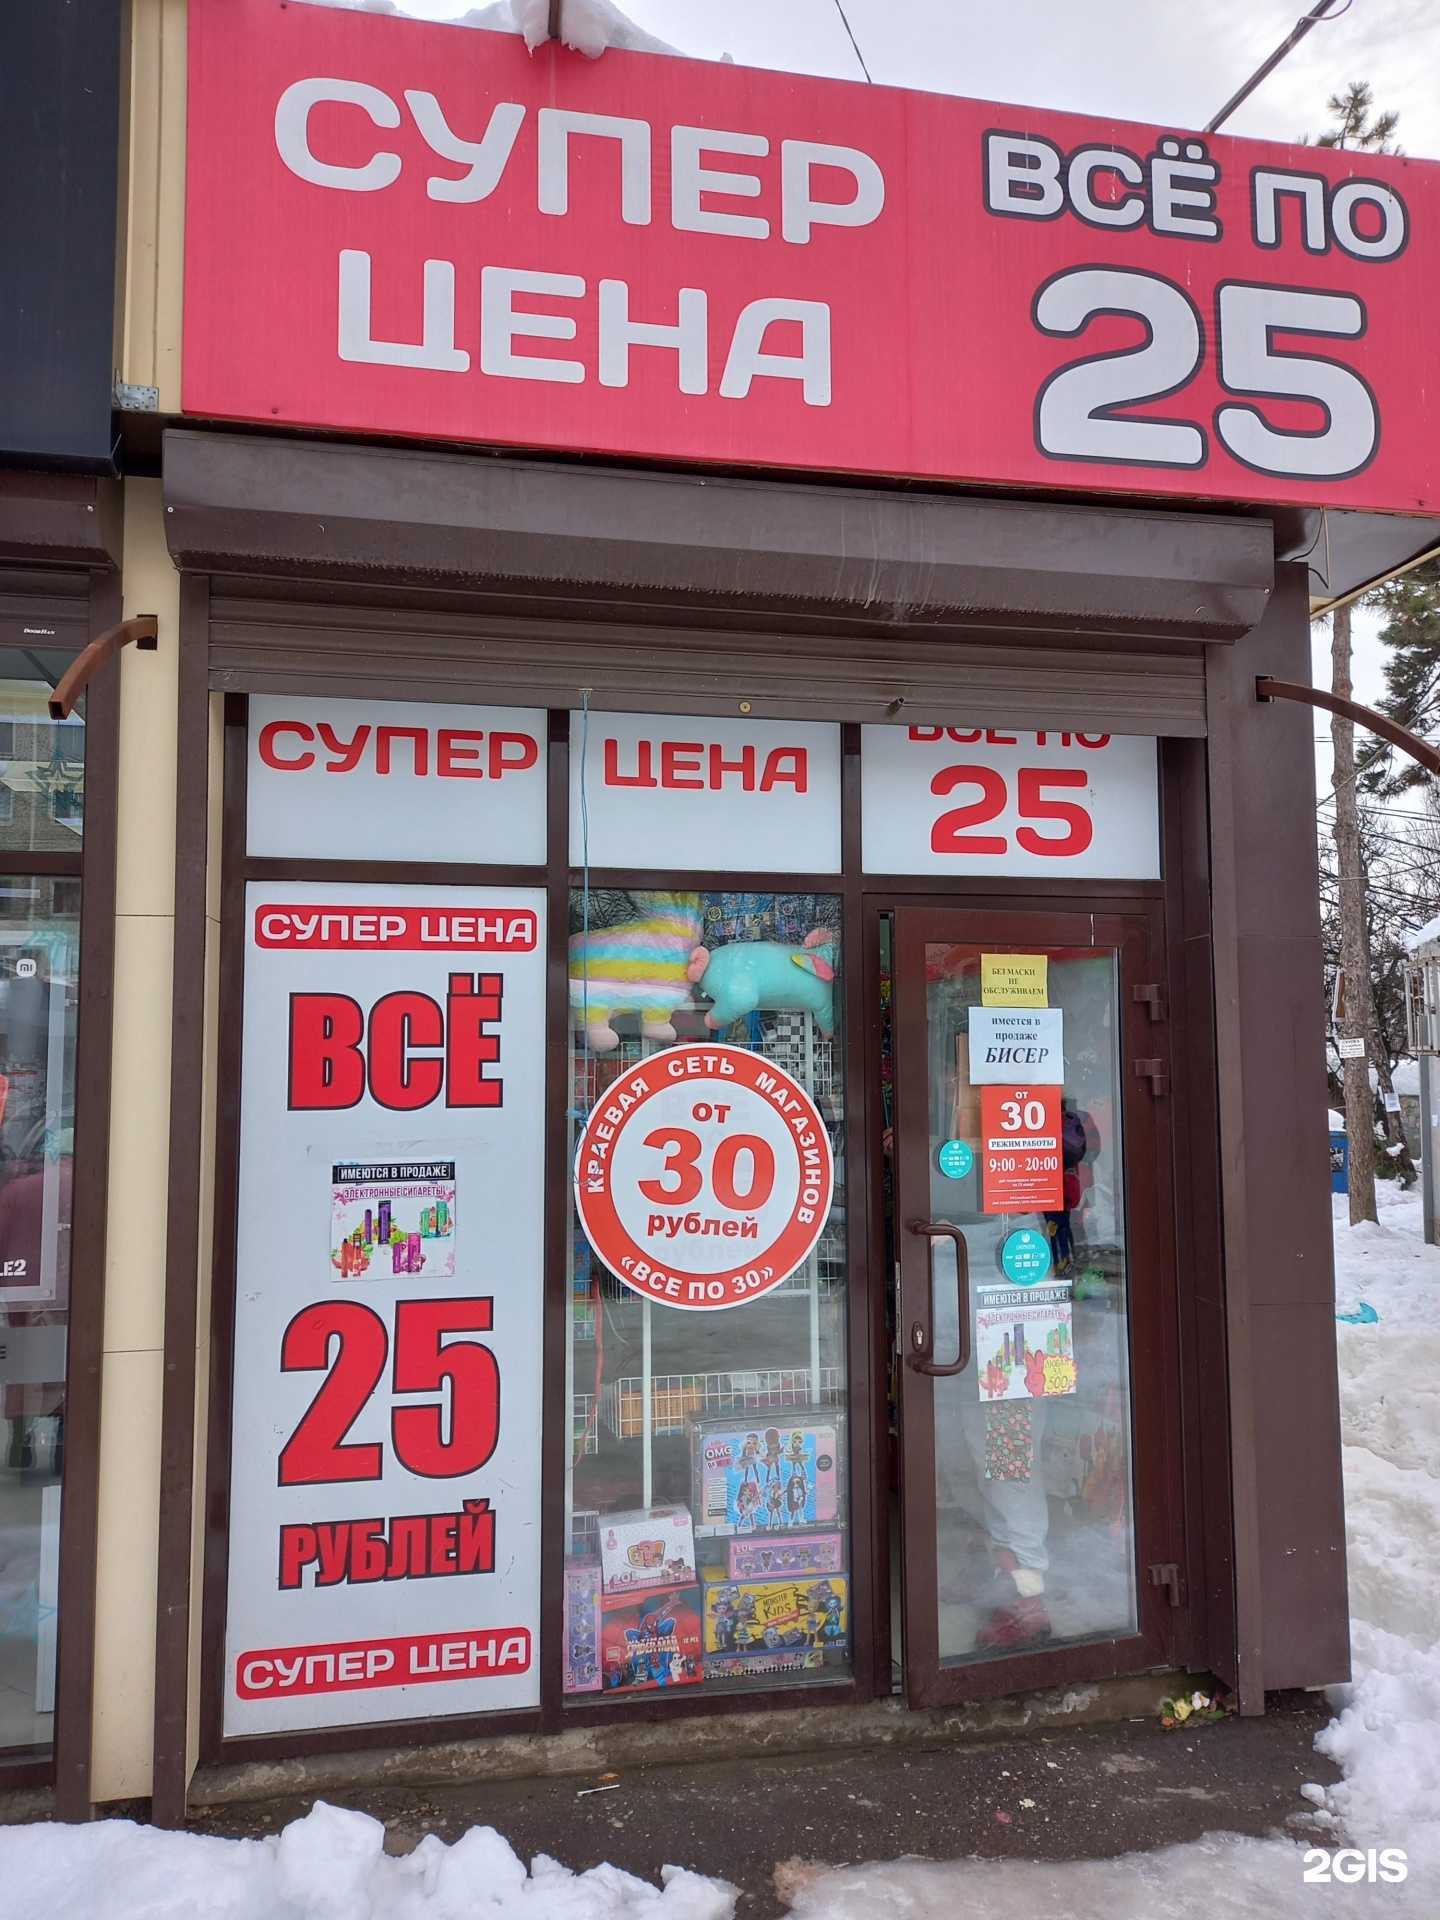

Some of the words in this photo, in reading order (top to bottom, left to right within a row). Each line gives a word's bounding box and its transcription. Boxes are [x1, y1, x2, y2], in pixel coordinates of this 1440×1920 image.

[275, 77, 885, 244] СУПЕР
[982, 128, 1222, 243] ВСЁ
[1251, 166, 1410, 263] ПО
[338, 249, 832, 407] ЦЕНА
[1031, 263, 1381, 481] 25
[258, 720, 539, 779] СУПЕР
[604, 738, 807, 793] ЦЕНА
[931, 765, 1093, 857] 25
[261, 914, 407, 941] СУПЕР
[421, 916, 532, 943] ЦЕНА
[1006, 968, 1035, 976] МАСКИ
[984, 987, 1044, 995] ОБСЛУЖИВАЕМ
[992, 1017, 1031, 1026] имеется
[1035, 1017, 1041, 1026] в
[995, 1031, 1038, 1042] продаже
[287, 972, 503, 1111] ВСЁ
[985, 1047, 1049, 1064] БИСЕР
[1000, 1101, 1046, 1131] 30
[587, 1077, 651, 1193] КРАЕВАЯ
[667, 1056, 735, 1077] СЕТЬ
[755, 1072, 823, 1225] МАГАЗИНОВ
[1022, 1140, 1054, 1148] РАБОТЫ
[341, 1167, 388, 1180] ИМЕЮТСЯ
[391, 1167, 397, 1177] В
[400, 1165, 447, 1178] ПРОДАЖЕ
[638, 1127, 776, 1212] 30
[990, 1158, 1015, 1172] 9:00
[1025, 1157, 1058, 1171] 20:00
[344, 1187, 401, 1199] ЭЛЕКТРОННЫЕ
[403, 1185, 444, 1197] СИГАРЕТЫ
[647, 1213, 759, 1239] рублей
[620, 1255, 683, 1297] «ВСЕ
[688, 1281, 724, 1299] ПО
[731, 1266, 774, 1294] 30»
[984, 1293, 1021, 1305] ИМЕЮТСЯ
[1023, 1292, 1028, 1302] В
[1030, 1289, 1067, 1302] ПРОДАЖЕ
[278, 1296, 500, 1487] 25
[704, 1445, 733, 1461] OMG
[278, 1498, 496, 1590] РУБЛЕЙ
[243, 1648, 395, 1691] СУПЕР
[409, 1636, 526, 1674] ЦЕНА
